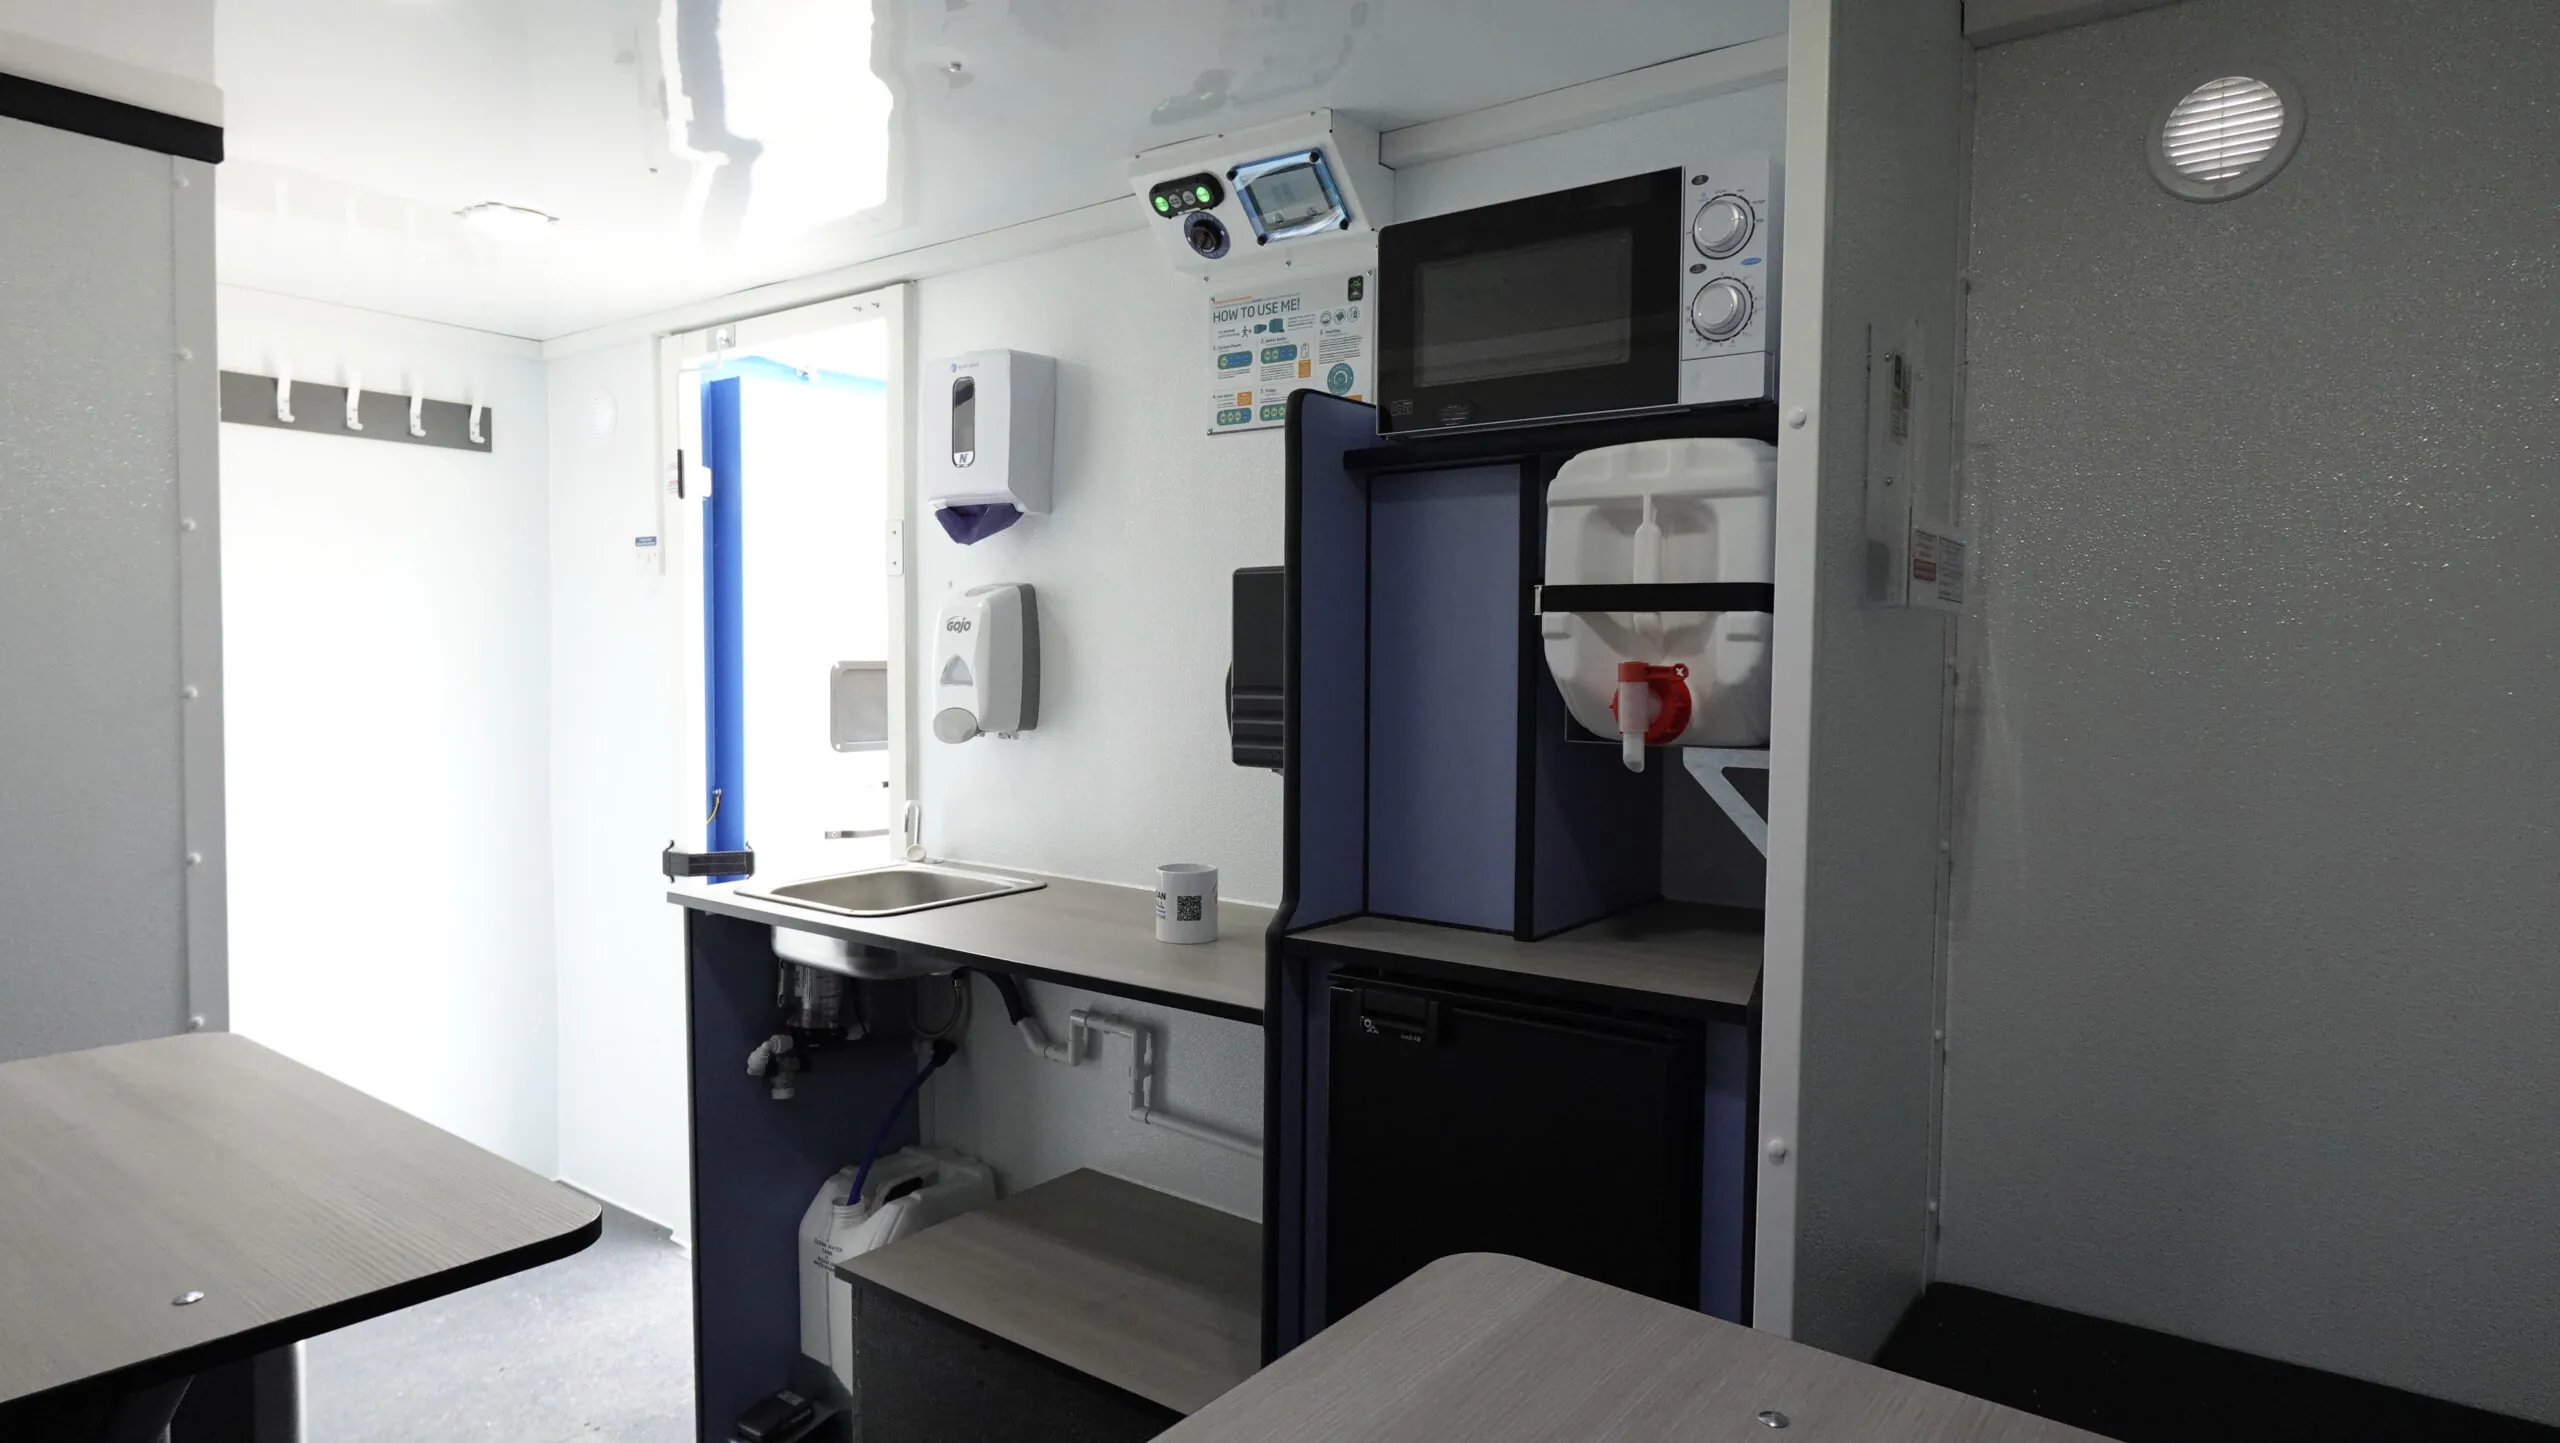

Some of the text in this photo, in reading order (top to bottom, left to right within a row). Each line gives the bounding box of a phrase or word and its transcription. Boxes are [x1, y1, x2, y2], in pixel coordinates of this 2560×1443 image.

[1213, 308, 1239, 324] HOW
[1241, 306, 1255, 320] TO
[1257, 302, 1278, 316] USE
[1280, 297, 1301, 312] ME!
